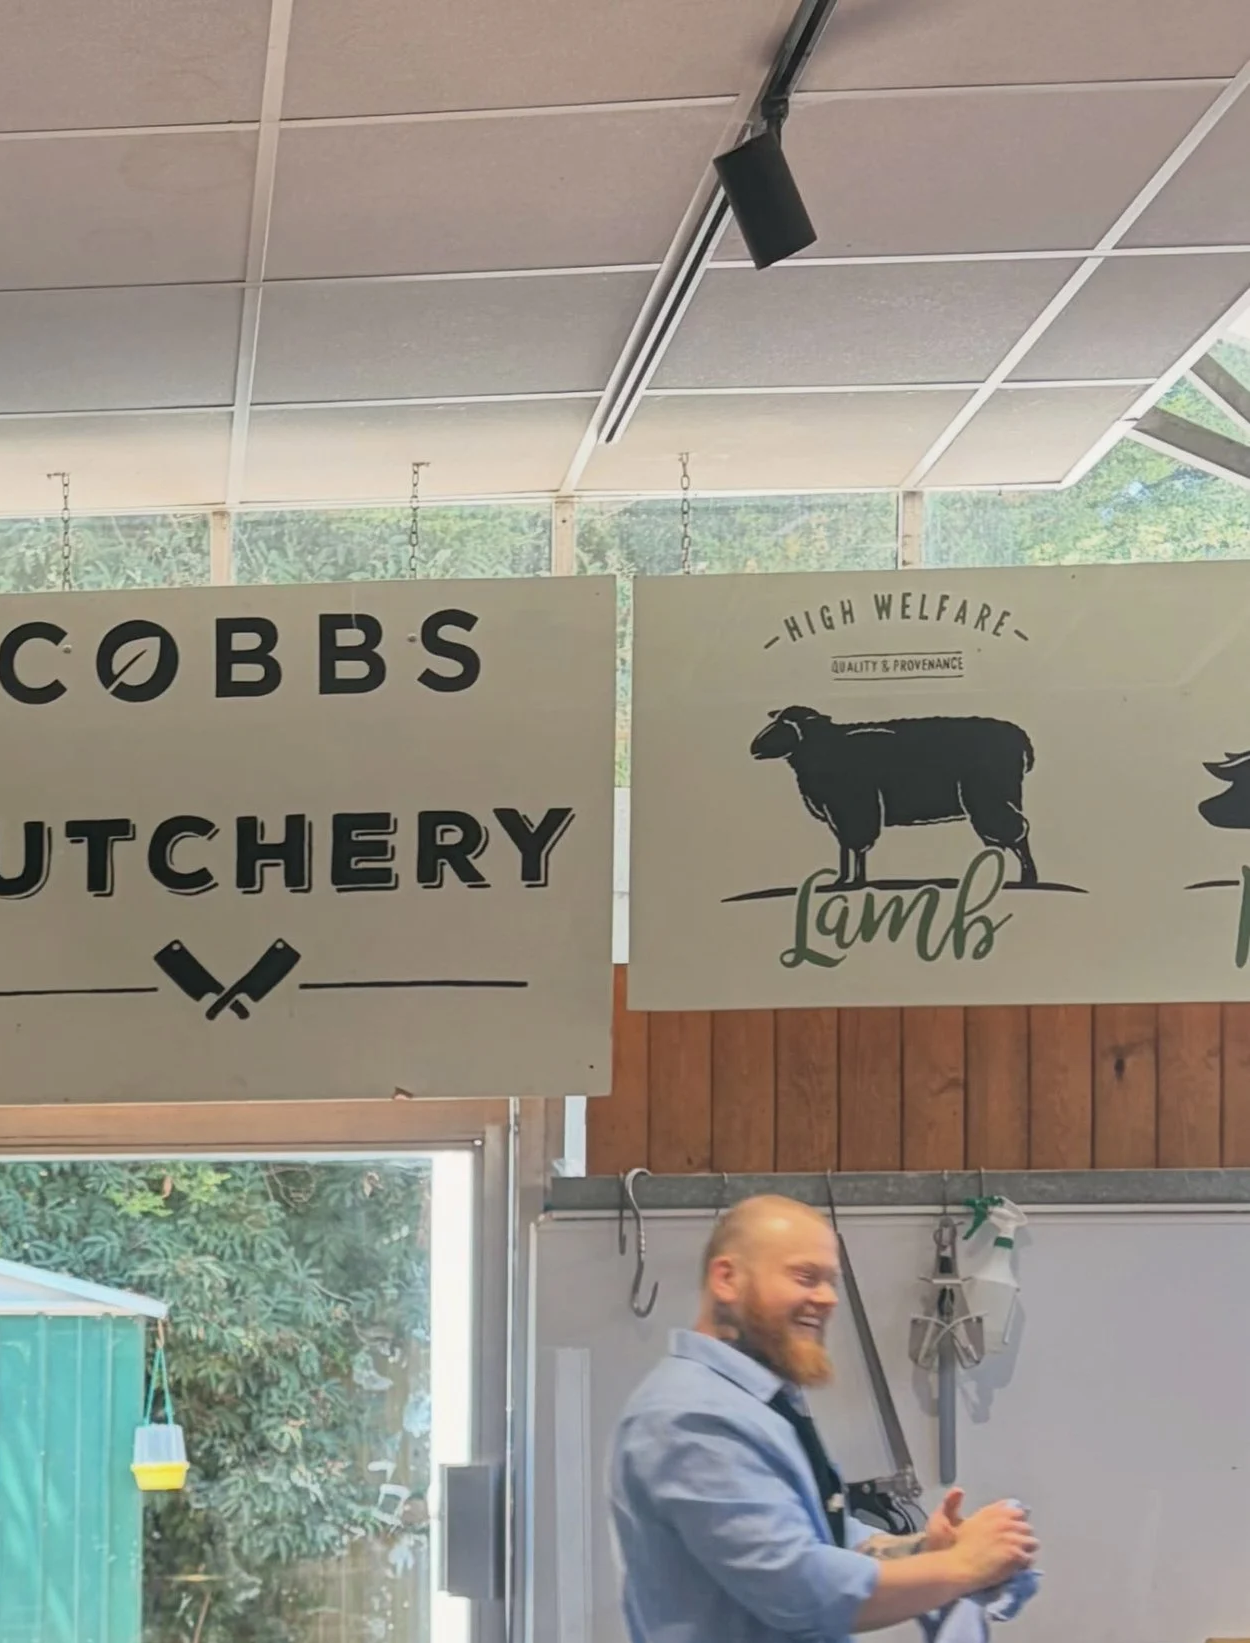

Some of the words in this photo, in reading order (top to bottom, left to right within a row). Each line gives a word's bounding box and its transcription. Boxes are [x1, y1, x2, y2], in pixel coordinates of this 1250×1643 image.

[784, 599, 855, 642] HIGH
[873, 592, 1011, 637] WELFARE
[831, 659, 878, 673] QUALITY
[881, 659, 891, 673] &
[893, 656, 964, 672] PROVENANCE
[780, 849, 1013, 968] Lamb
